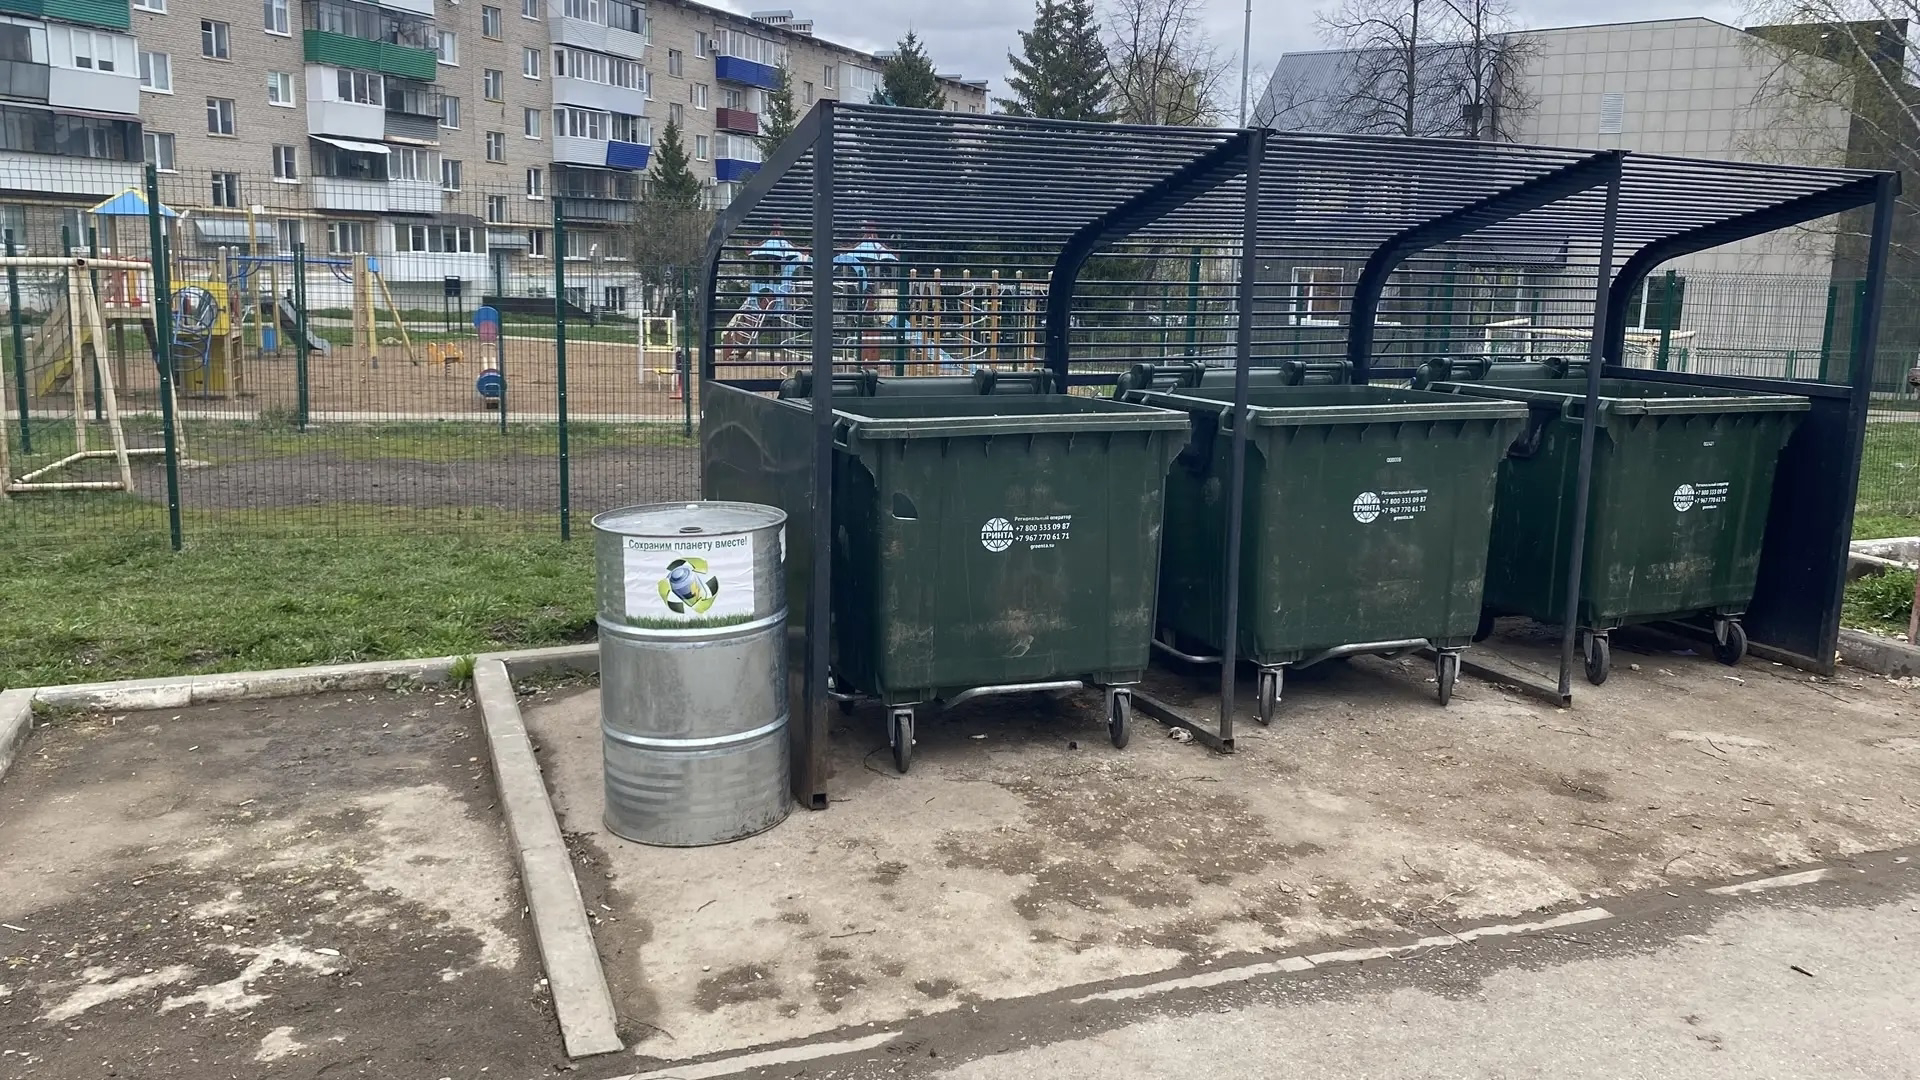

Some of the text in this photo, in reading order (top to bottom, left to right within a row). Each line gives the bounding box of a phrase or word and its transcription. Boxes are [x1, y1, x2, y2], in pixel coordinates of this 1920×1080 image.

[628, 536, 747, 551] Сохраним планету вместе!
